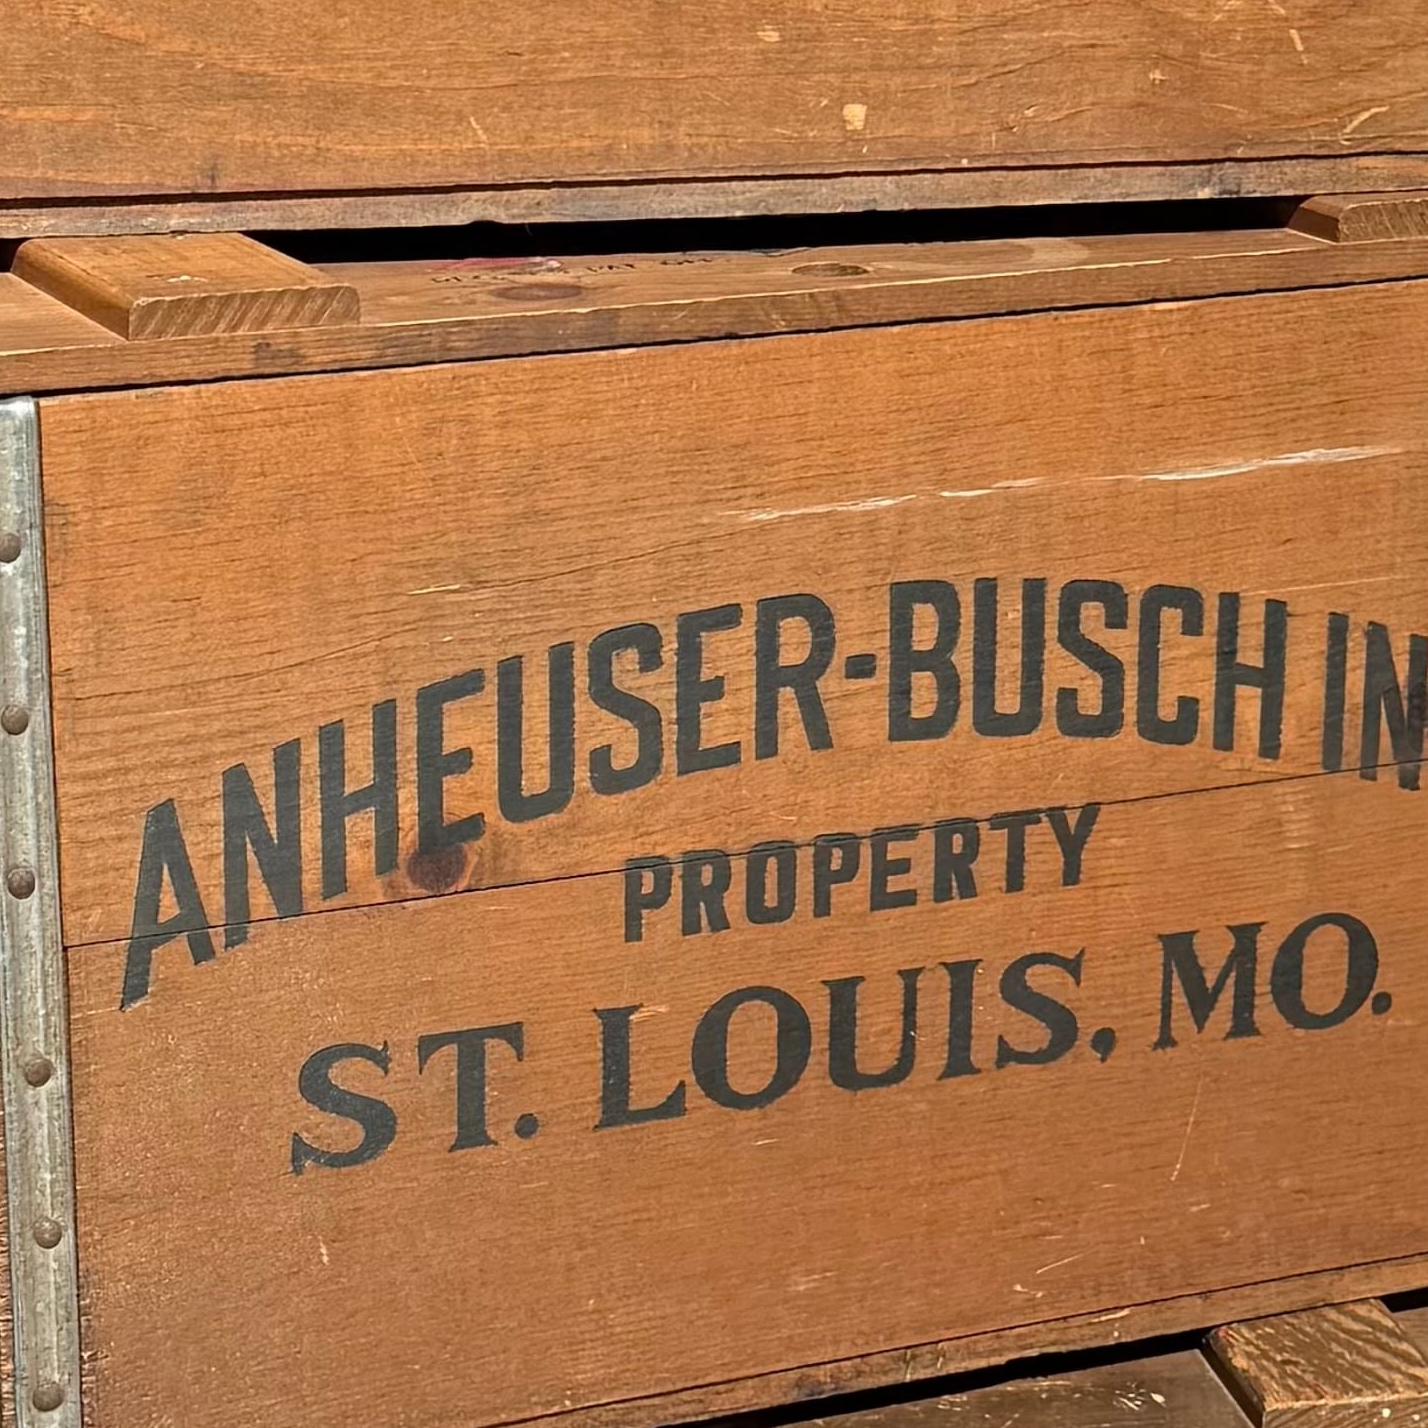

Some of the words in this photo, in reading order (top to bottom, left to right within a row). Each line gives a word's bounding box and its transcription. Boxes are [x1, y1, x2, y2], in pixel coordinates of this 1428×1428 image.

[118, 576, 1288, 1012] ANHEUSER-BUSCH
[622, 802, 1103, 943] PROPERTY
[289, 1023, 539, 1175] ST.
[590, 950, 1117, 1132] LOUIS,
[1149, 910, 1395, 1052] MO.
